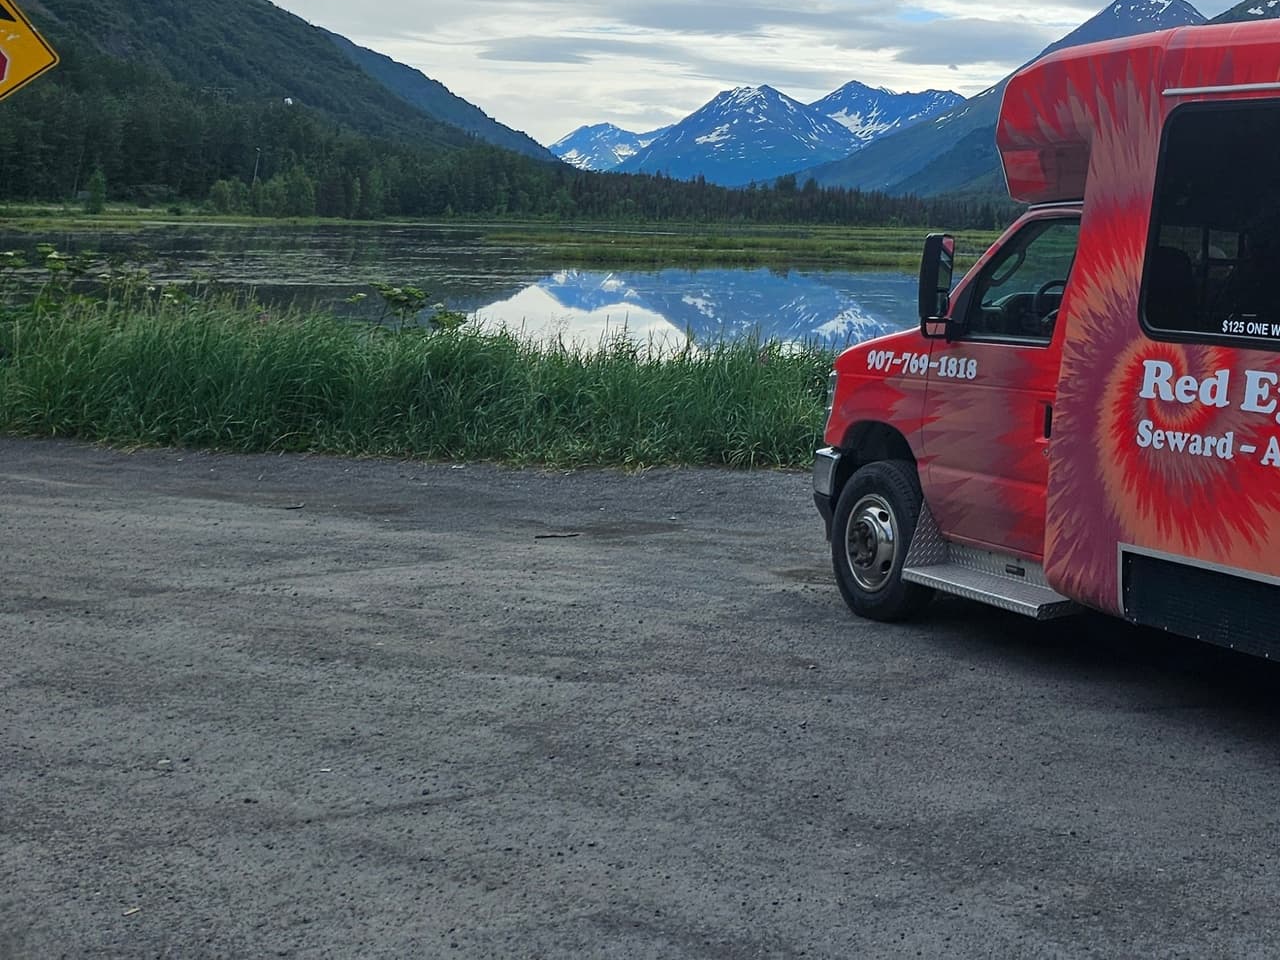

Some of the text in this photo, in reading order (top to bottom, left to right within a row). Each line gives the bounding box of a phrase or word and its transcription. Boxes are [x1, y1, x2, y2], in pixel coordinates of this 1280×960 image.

[1222, 319, 1245, 333] $125
[1246, 321, 1269, 336] ONE
[867, 350, 977, 379] 907-769-1818
[1139, 359, 1231, 409] Red
[1136, 419, 1235, 460] Seward
